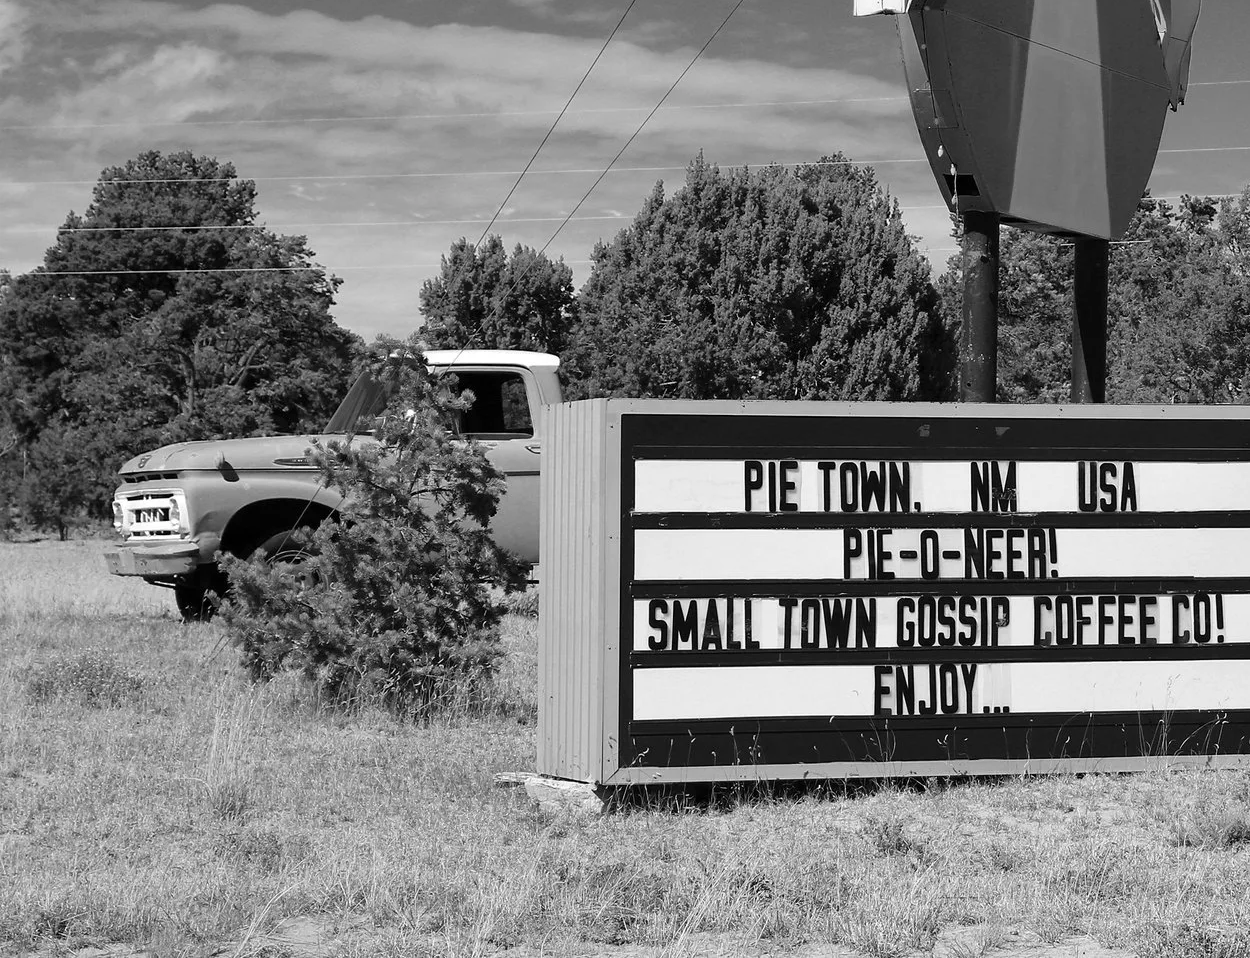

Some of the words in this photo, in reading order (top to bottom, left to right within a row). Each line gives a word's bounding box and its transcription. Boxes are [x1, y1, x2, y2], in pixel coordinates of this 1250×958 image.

[744, 460, 799, 512] PIE
[818, 461, 922, 513] TOWN,
[970, 460, 1017, 513] NM
[1078, 460, 1138, 512] USA
[844, 528, 1059, 580] PIE-O-NEER!
[648, 598, 760, 650] SMALL
[779, 597, 876, 648] TOWN
[897, 595, 1010, 647] GOSSIP
[1033, 593, 1157, 647] COFFEE
[1172, 592, 1225, 644] CO!
[874, 663, 1010, 716] ENJOY...
